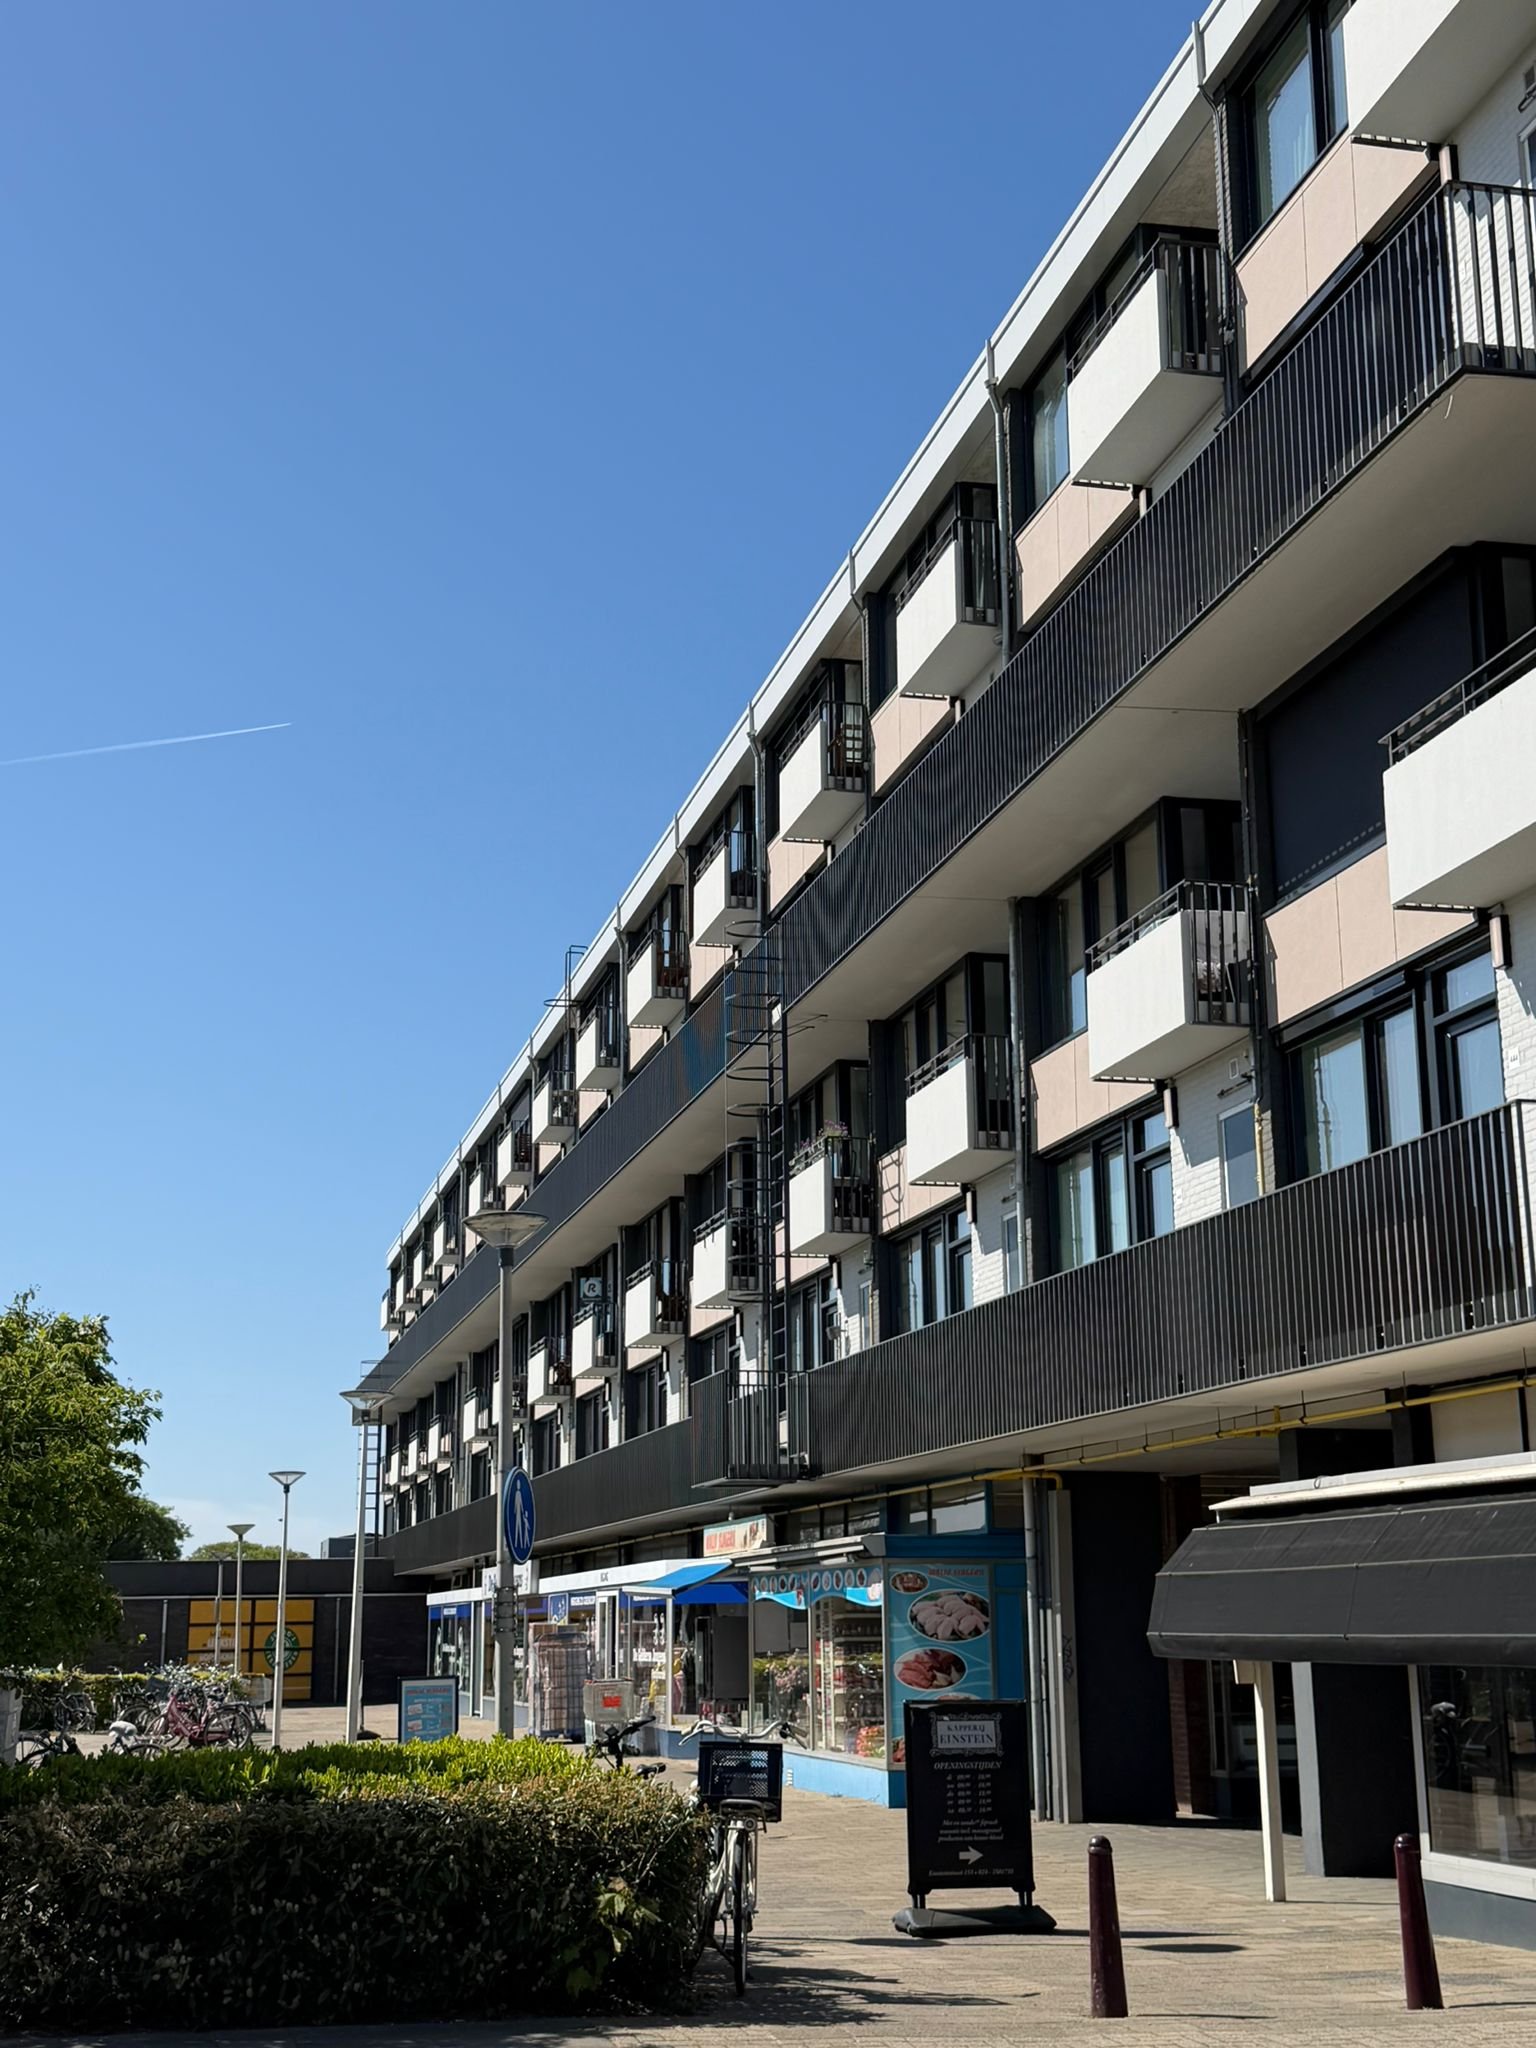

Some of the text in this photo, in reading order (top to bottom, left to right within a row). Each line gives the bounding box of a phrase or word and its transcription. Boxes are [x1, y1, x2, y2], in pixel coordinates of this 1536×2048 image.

[588, 1283, 596, 1293] R
[940, 1734, 993, 1744] EINSTEIN
[934, 1761, 1002, 1770] OPENINGSTIJDEN
